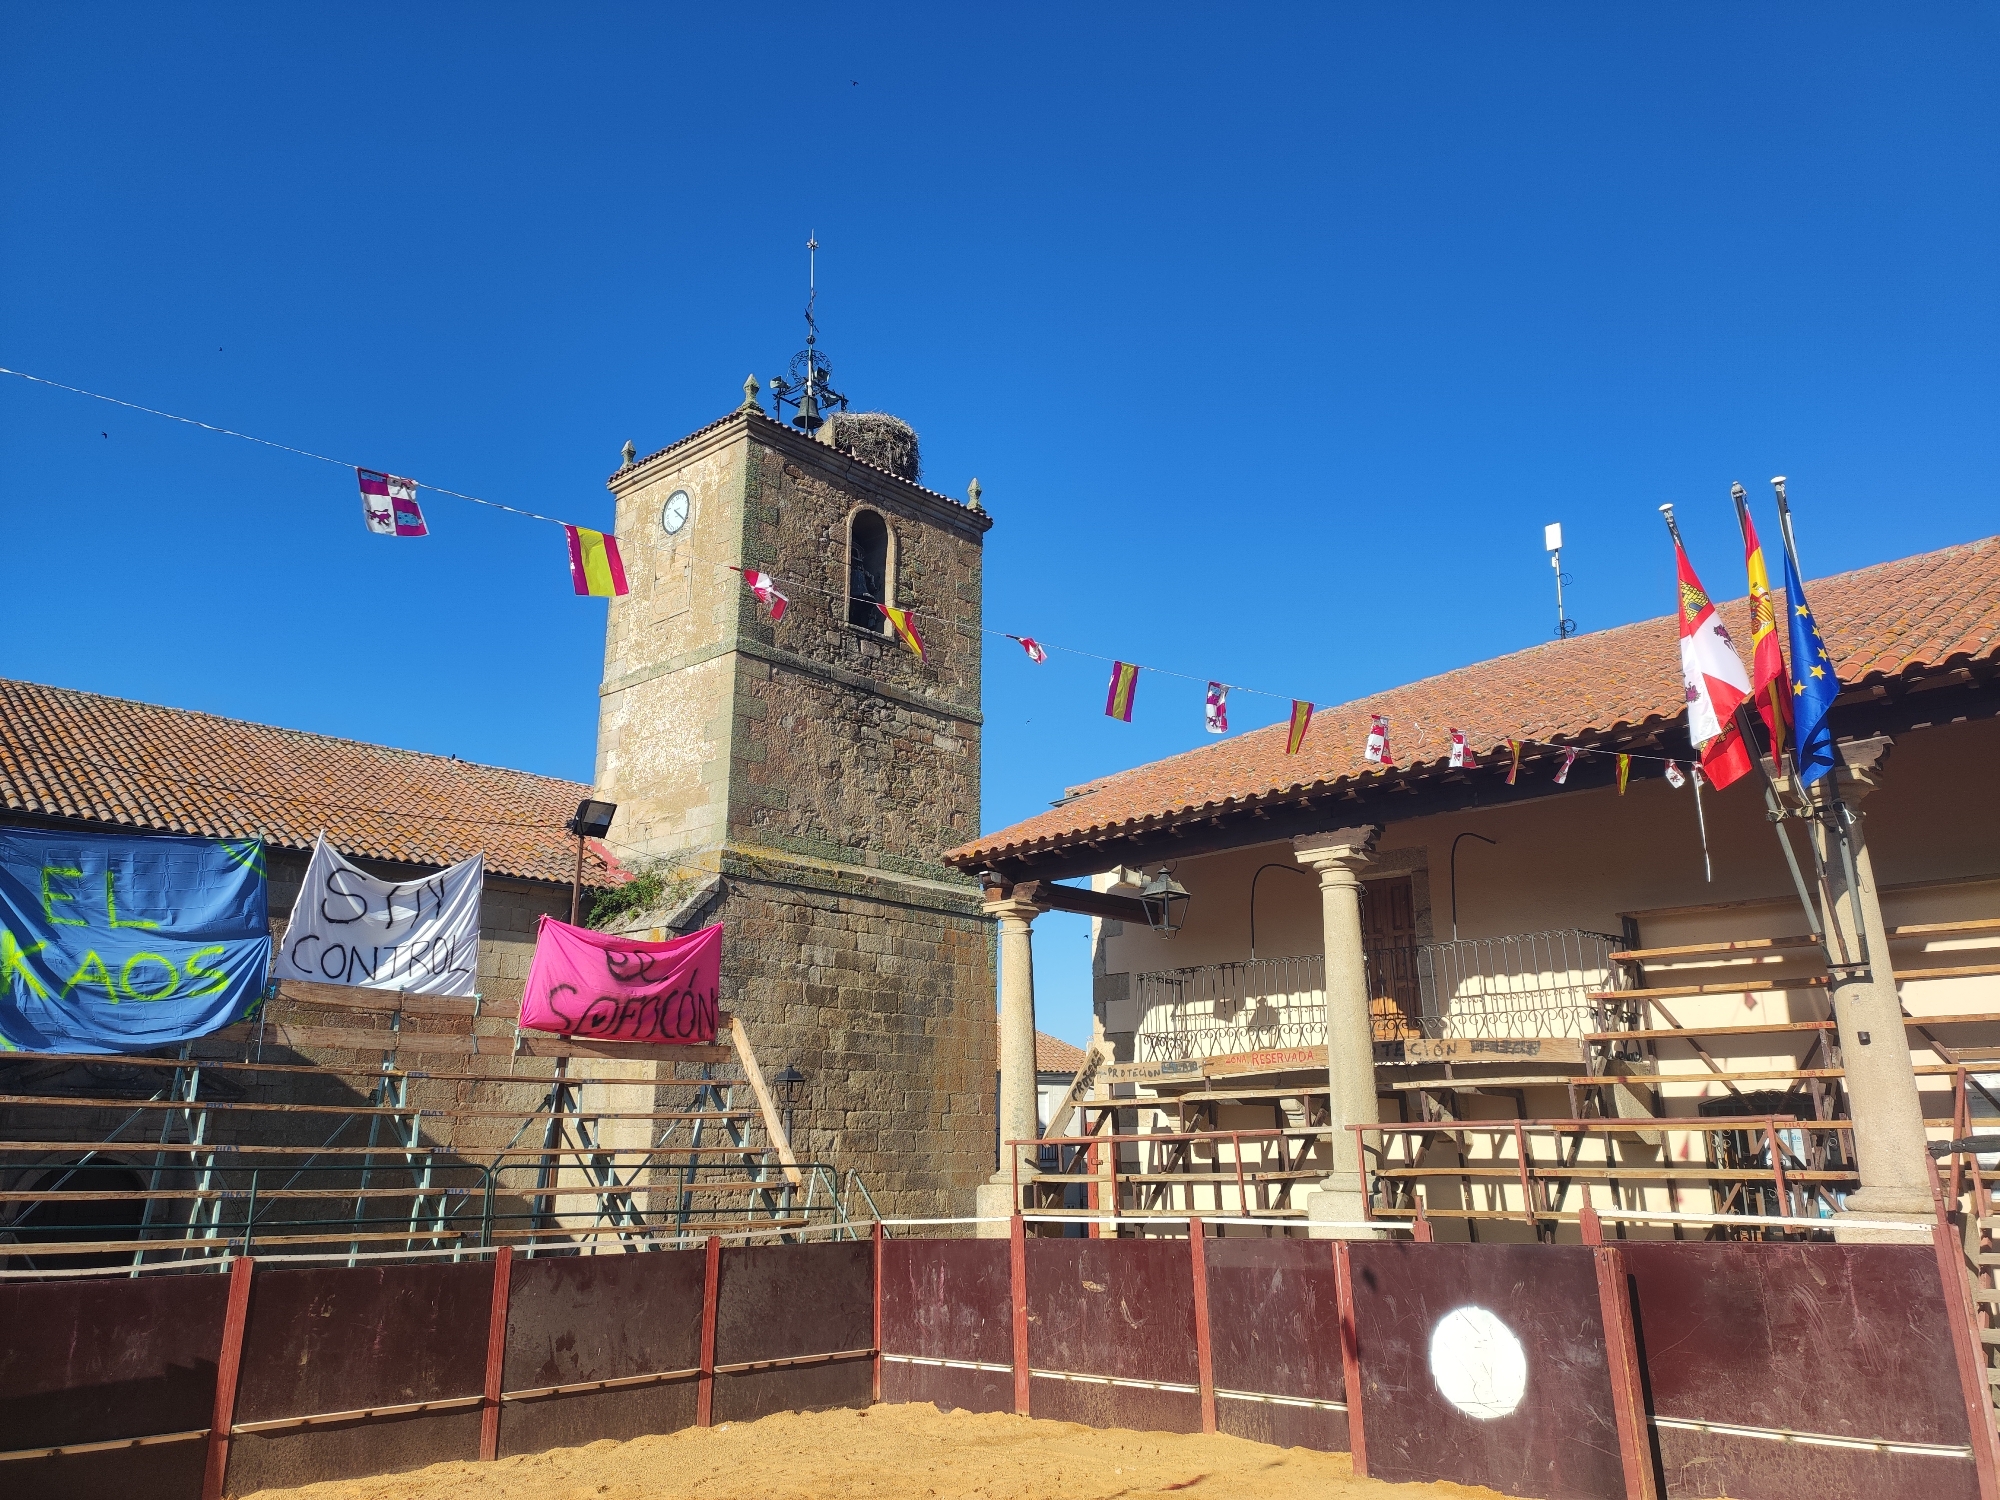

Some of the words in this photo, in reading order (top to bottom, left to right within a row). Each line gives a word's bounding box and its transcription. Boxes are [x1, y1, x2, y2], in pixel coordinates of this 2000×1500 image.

[42, 867, 159, 929] EL
[321, 867, 448, 929] SIN
[0, 929, 229, 1005] KAOS
[292, 935, 469, 982] CONTROL
[1251, 1050, 1315, 1066] RESERVADA
